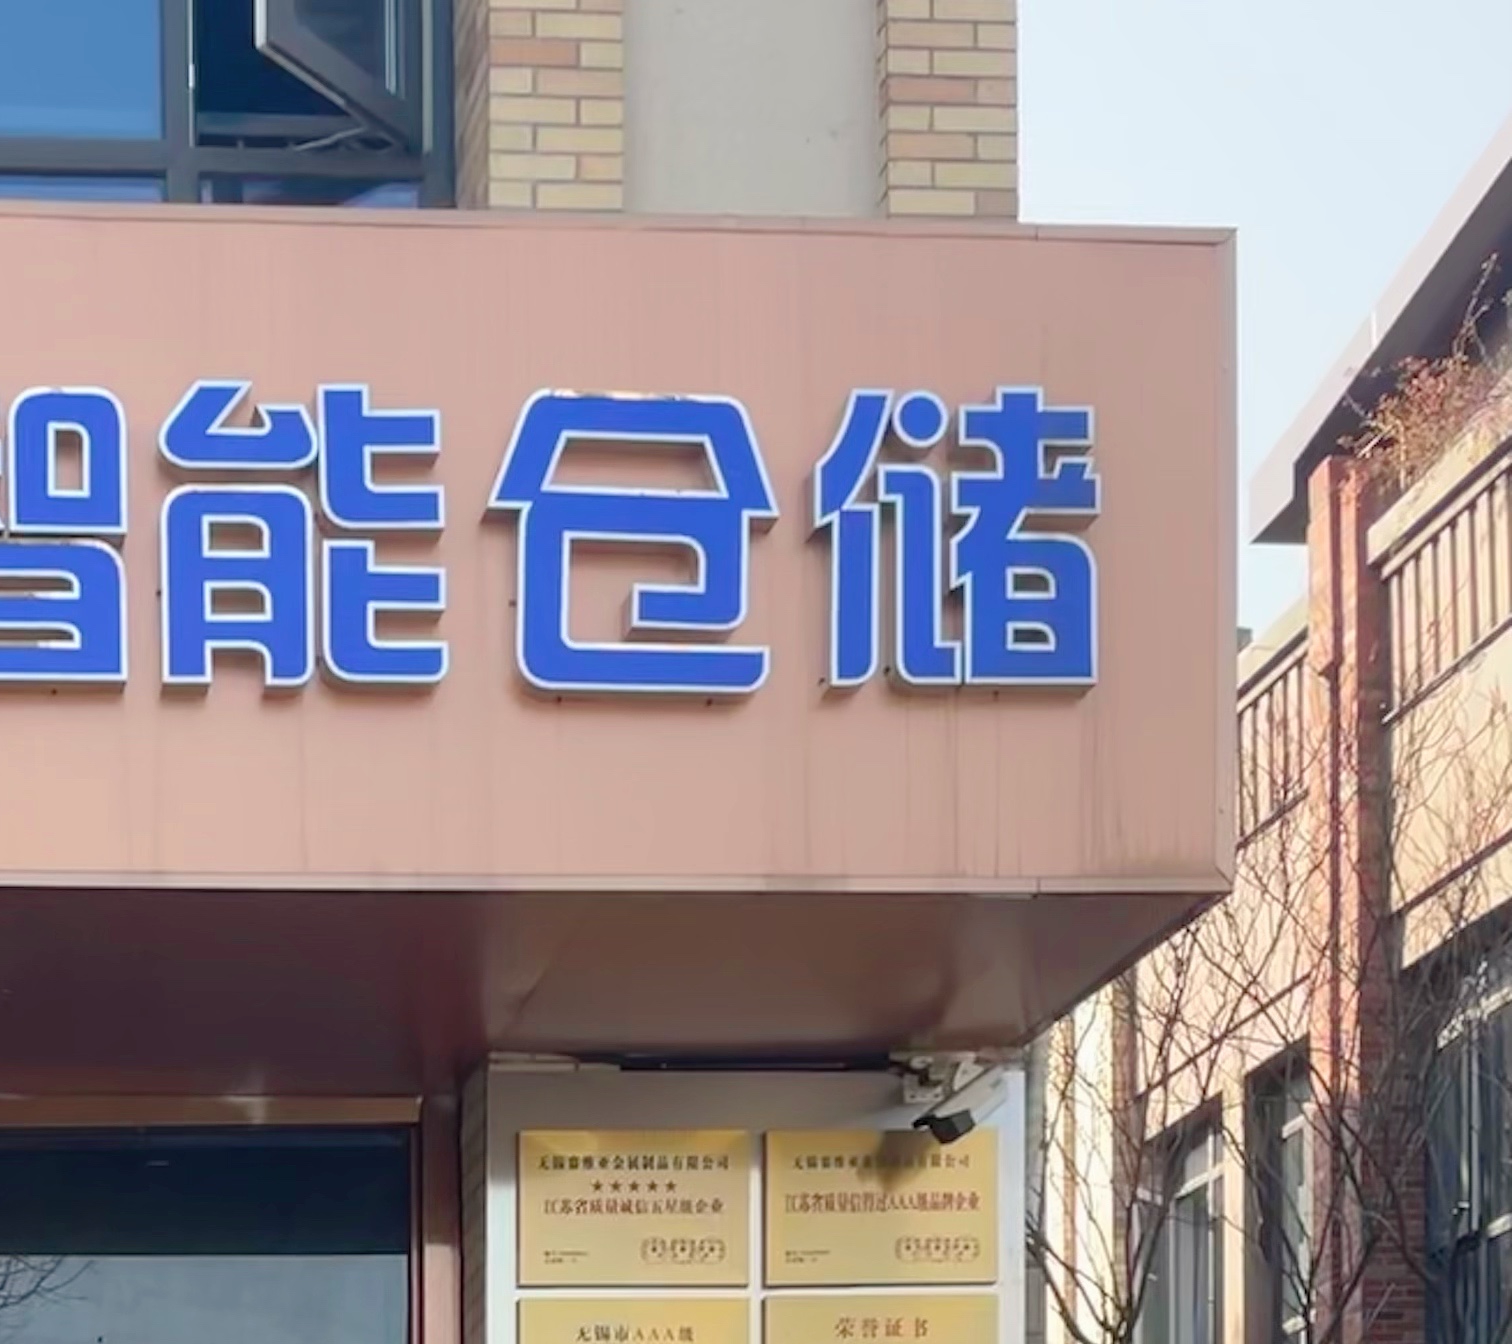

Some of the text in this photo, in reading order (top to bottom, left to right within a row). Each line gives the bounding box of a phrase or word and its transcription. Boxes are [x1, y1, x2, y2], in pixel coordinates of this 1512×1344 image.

[575, 1324, 695, 1342] 无锡市AAA级
[834, 1316, 929, 1339] 荣誉证书
